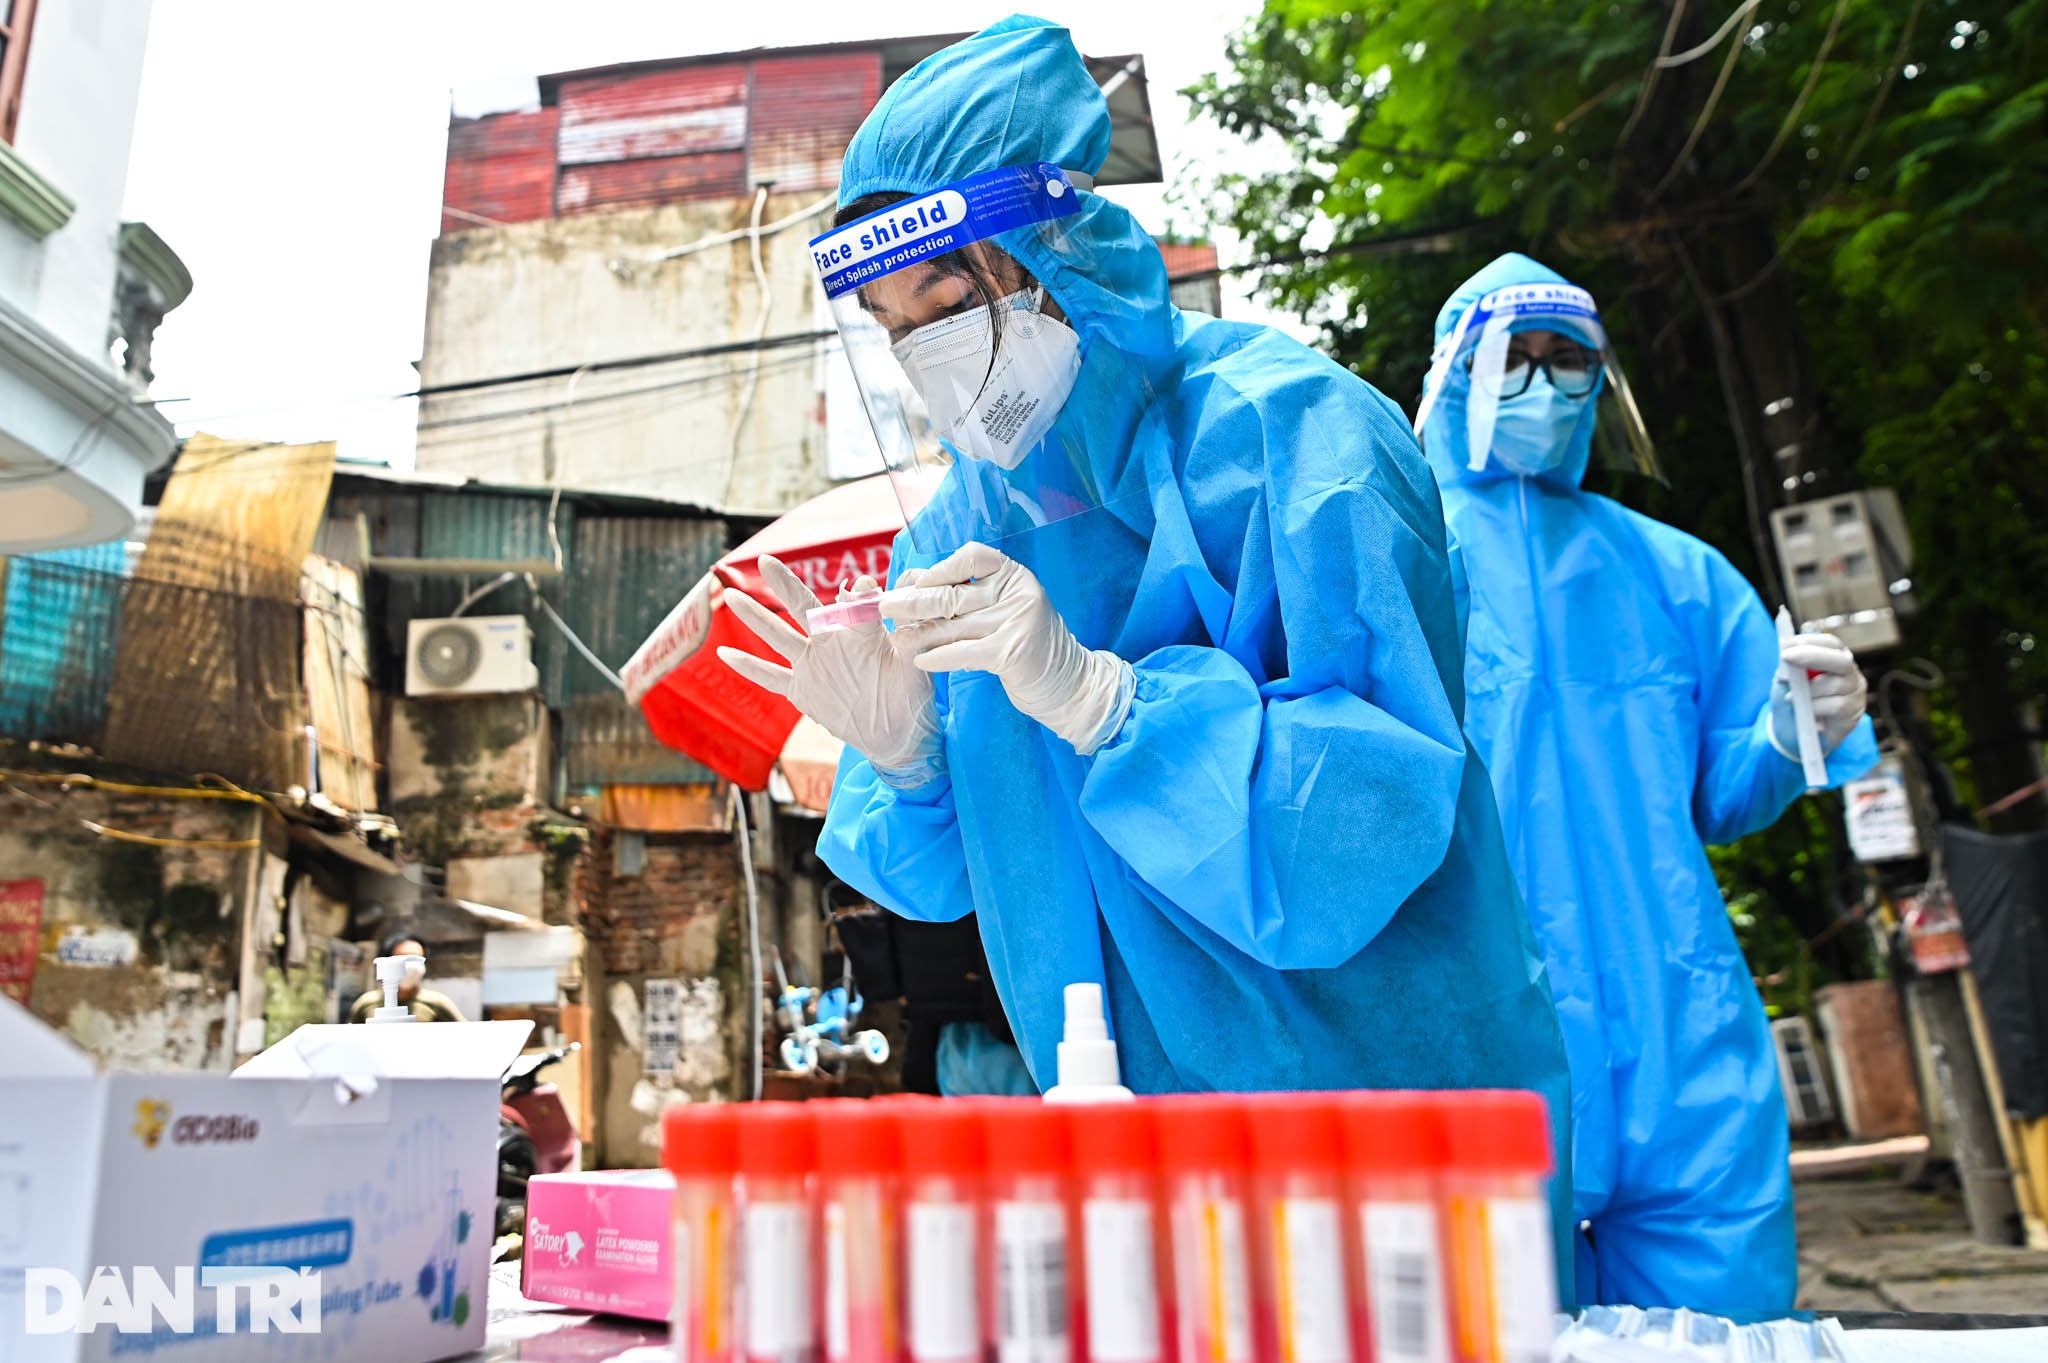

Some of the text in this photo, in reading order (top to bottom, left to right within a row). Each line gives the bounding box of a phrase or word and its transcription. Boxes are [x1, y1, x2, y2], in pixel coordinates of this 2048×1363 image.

[814, 199, 949, 271] Face shield
[825, 234, 954, 292] Direct Splash protection
